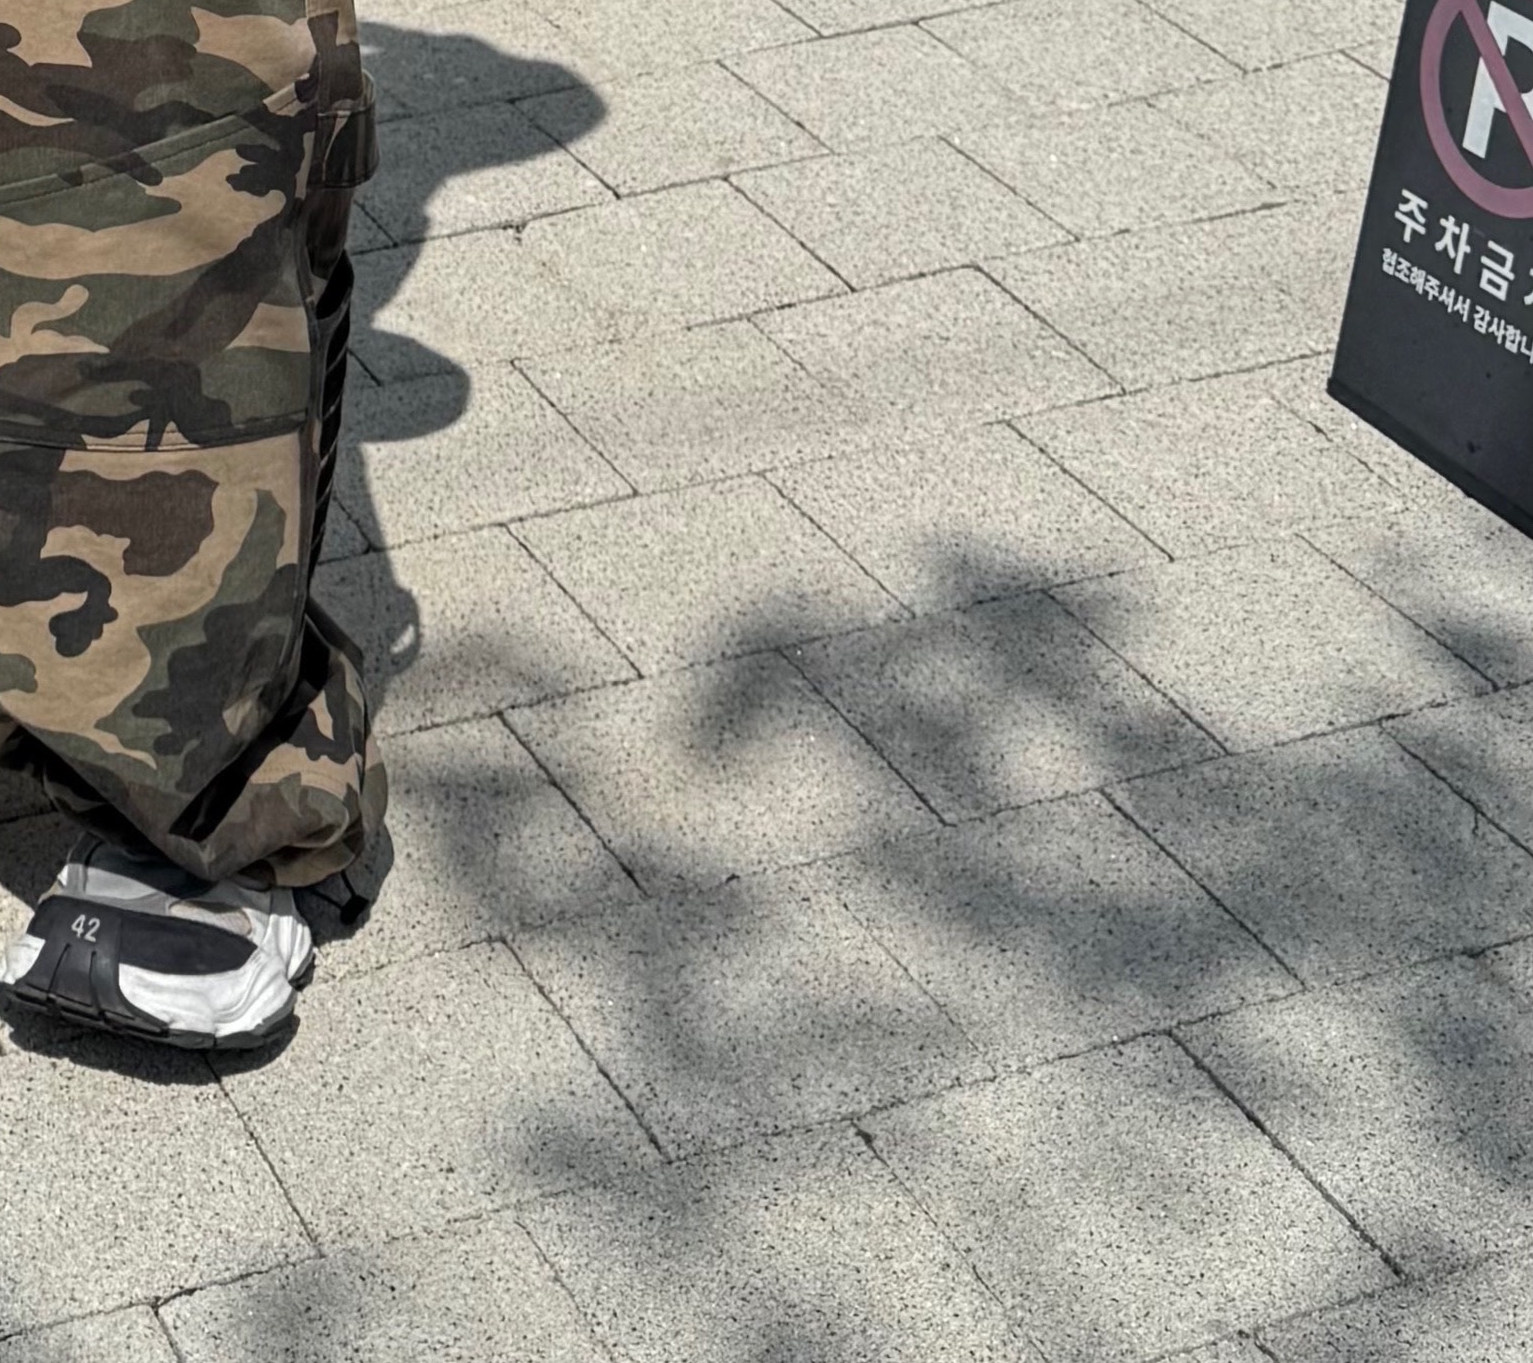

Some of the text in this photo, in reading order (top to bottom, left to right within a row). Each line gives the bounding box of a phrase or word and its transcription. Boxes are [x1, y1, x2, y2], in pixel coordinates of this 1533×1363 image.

[1394, 188, 1533, 305] 주차금
[1382, 247, 1471, 323] 협조해주셔서
[71, 914, 100, 943] 42
